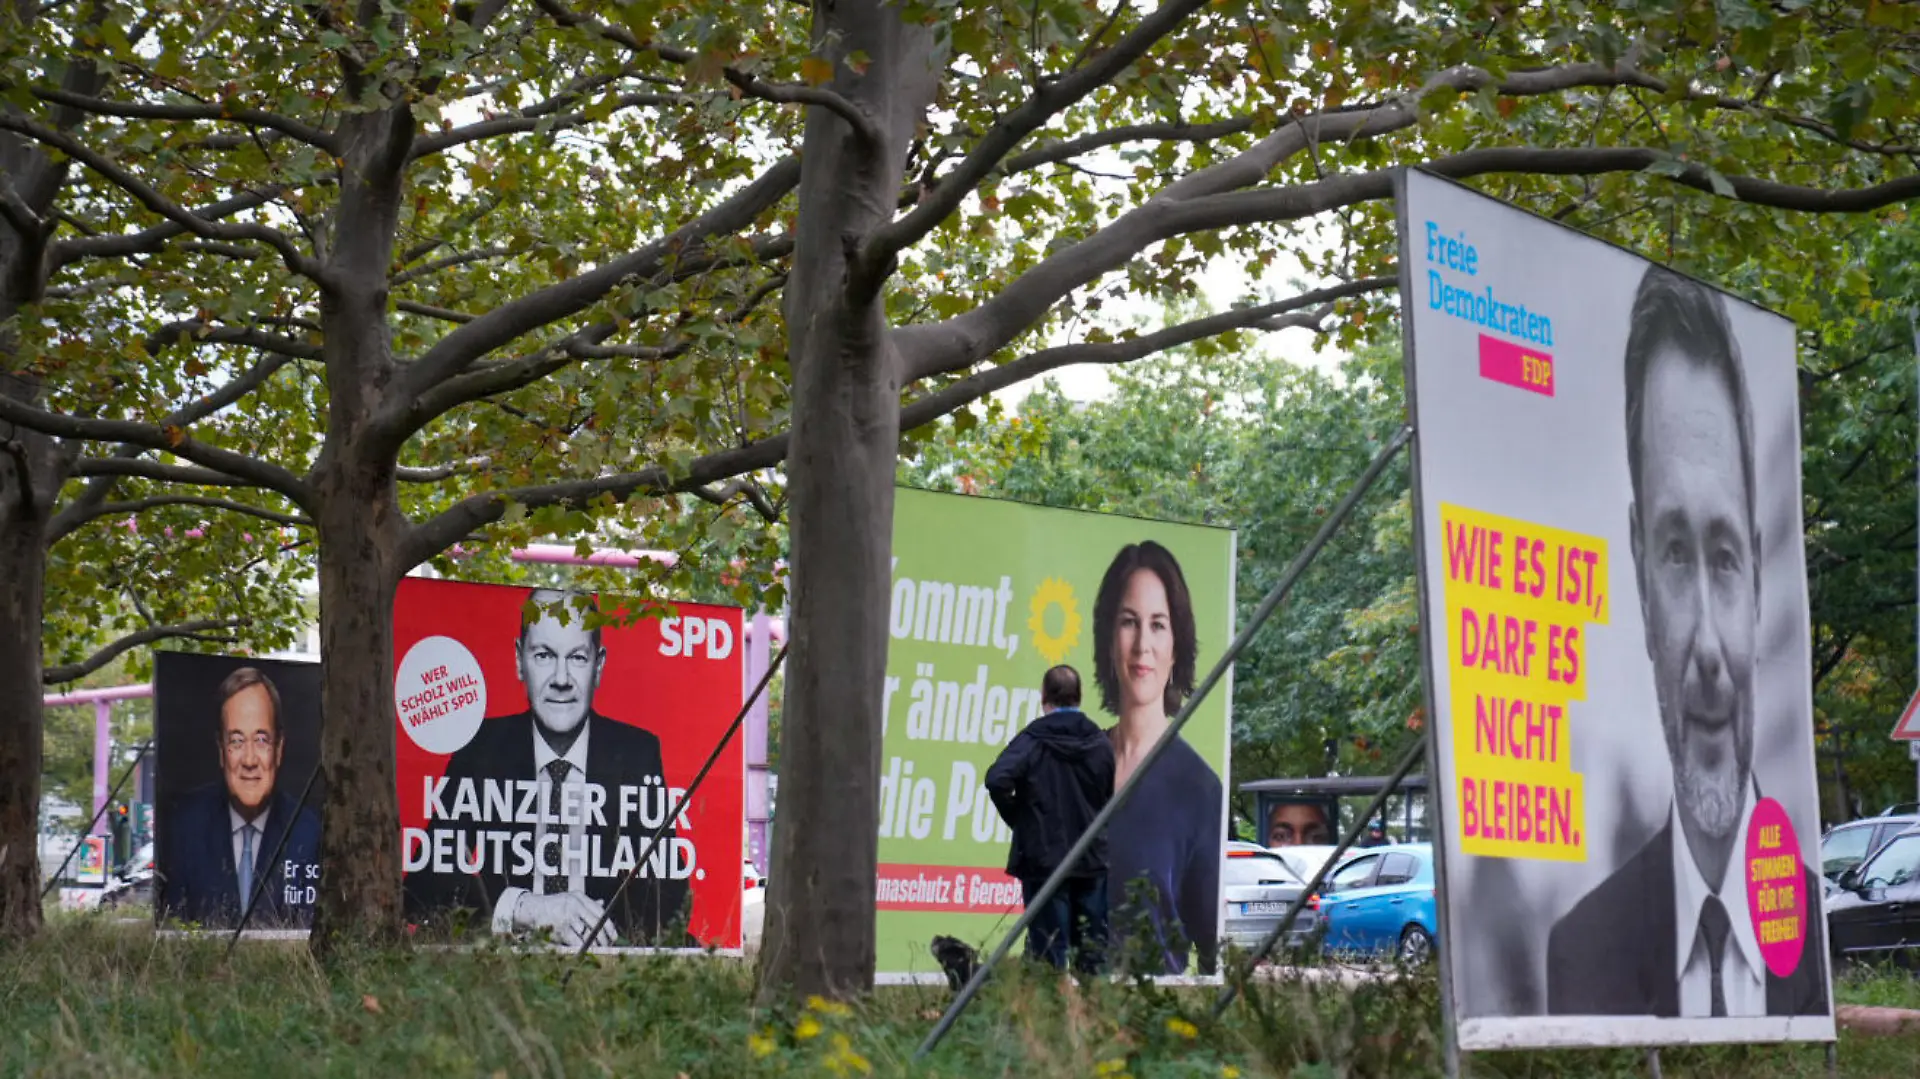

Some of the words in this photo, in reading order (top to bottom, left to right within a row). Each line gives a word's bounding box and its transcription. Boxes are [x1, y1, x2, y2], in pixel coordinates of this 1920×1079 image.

[1425, 220, 1478, 276] Freie
[1428, 269, 1553, 346] Demokraten
[1522, 355, 1551, 387] FDP
[1446, 520, 1503, 589] WIE
[1513, 536, 1546, 598] ES
[1556, 545, 1603, 619] IST,
[890, 556, 1019, 660] ommt,
[658, 616, 733, 659] SPD
[1461, 607, 1537, 677] DARF
[1547, 624, 1579, 685] ES
[421, 665, 448, 685] WER
[401, 685, 445, 713] SCHOLZ
[409, 701, 450, 727] WÄHLT
[451, 688, 478, 710] SPD!
[1475, 694, 1562, 763] NICHT
[423, 775, 607, 827] KANZLER
[619, 775, 692, 830] FÜR
[879, 757, 936, 840] die
[1462, 776, 1580, 847] BLEIBEN.
[402, 827, 706, 881] DEUTSCHLAND.
[1759, 824, 1781, 849] ALLE
[284, 860, 300, 878] Er
[305, 864, 320, 879] sc
[1751, 854, 1797, 881] STIMMEN
[284, 884, 304, 904] für
[954, 874, 965, 904] &
[969, 874, 1024, 907] Gerech
[1758, 882, 1777, 913] FÜR
[1778, 885, 1795, 909] DIE
[1760, 916, 1799, 944] FREIHEIT
